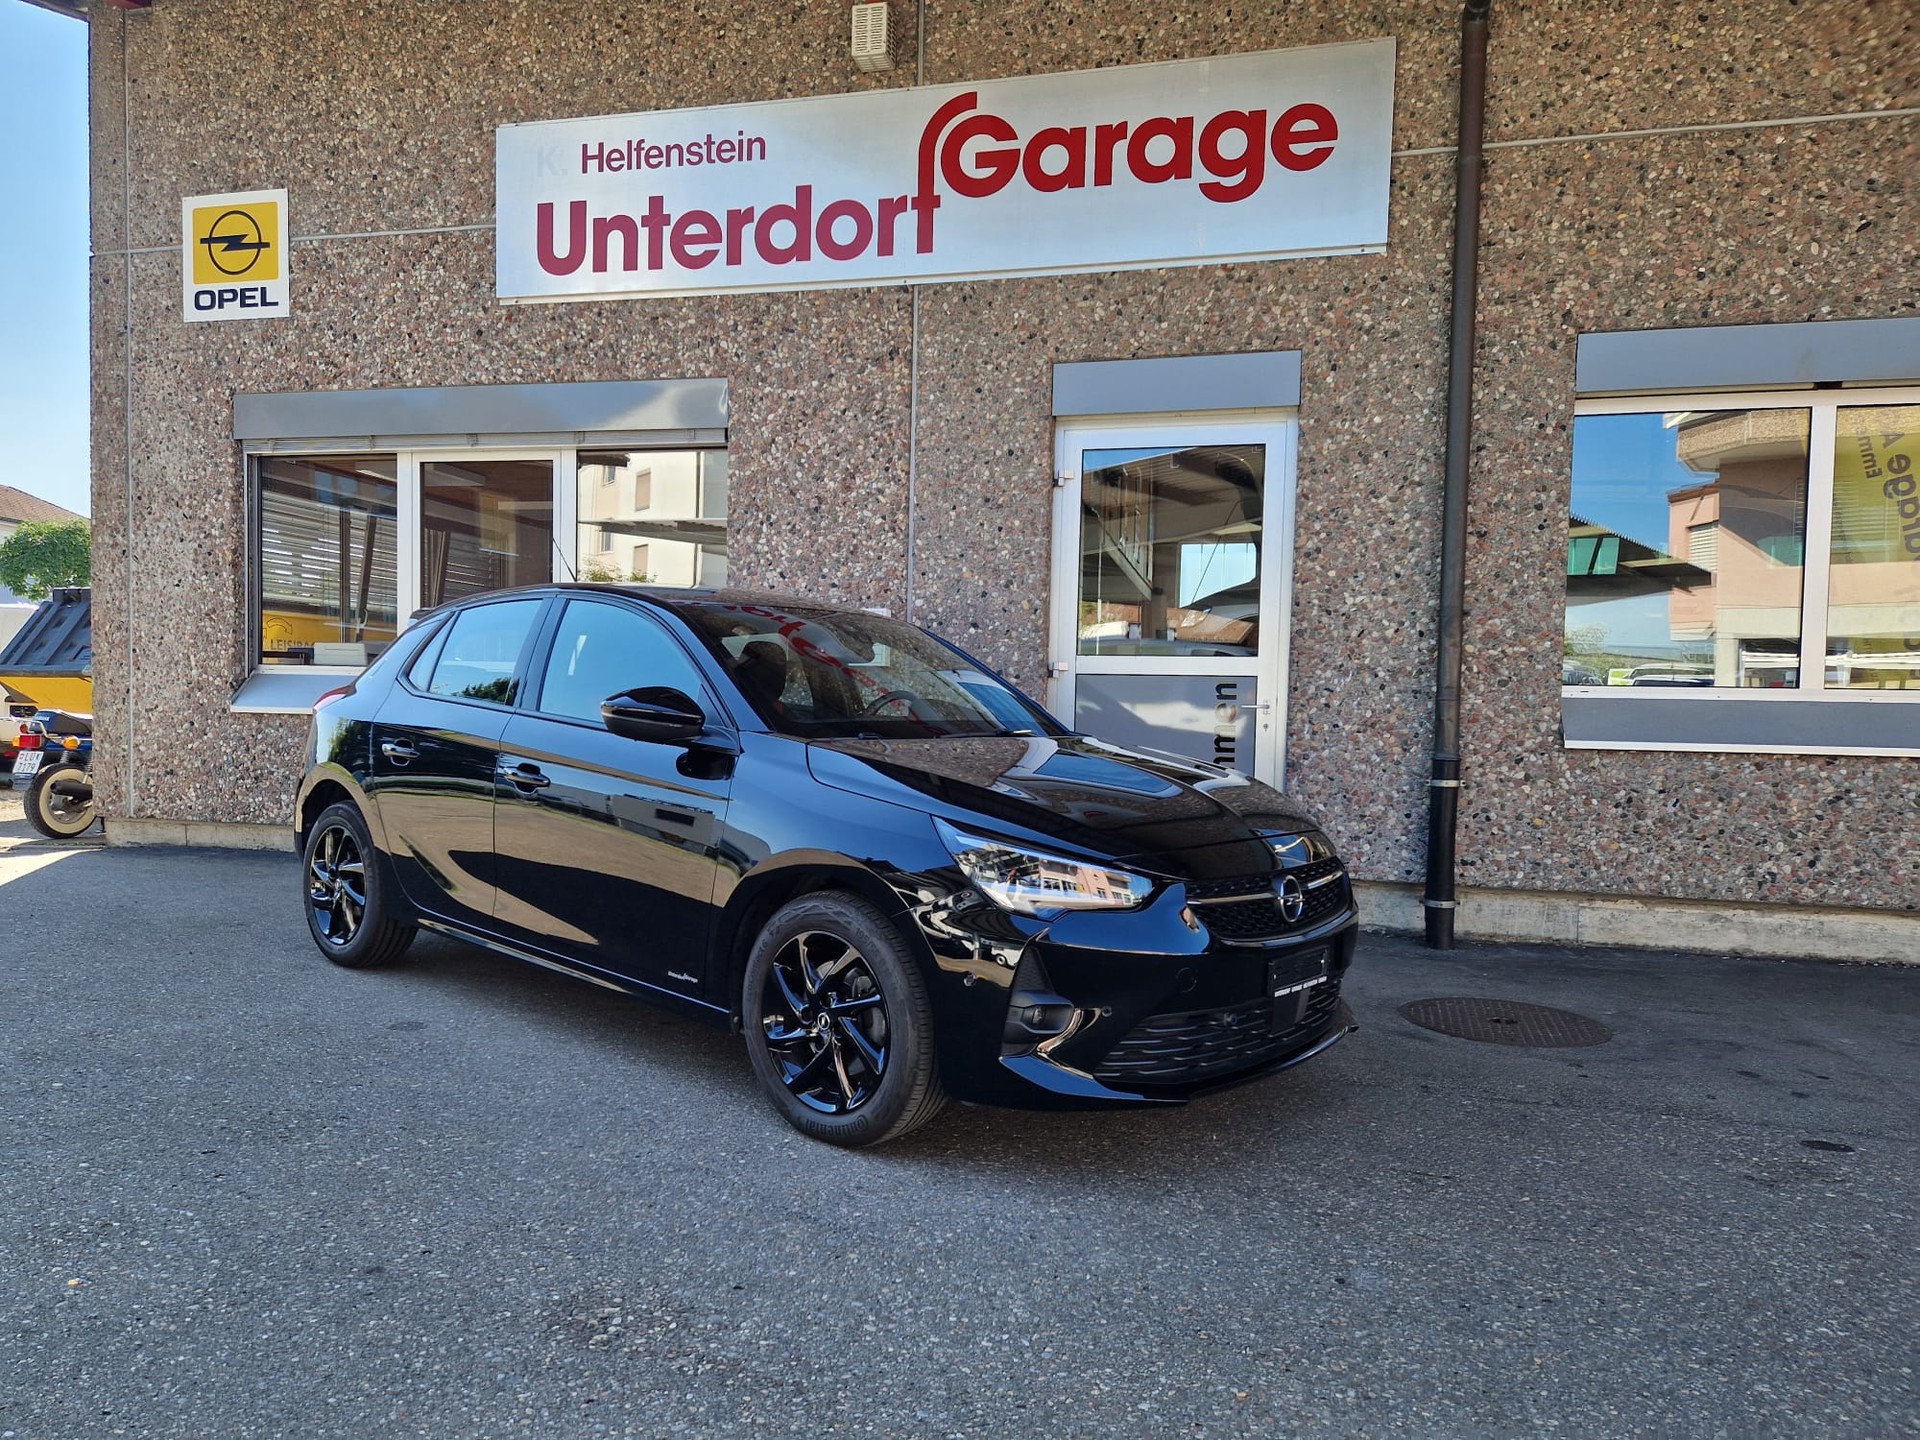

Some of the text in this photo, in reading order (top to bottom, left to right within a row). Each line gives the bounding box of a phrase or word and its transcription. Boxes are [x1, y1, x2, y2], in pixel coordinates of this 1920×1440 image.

[582, 130, 767, 174] Helfenstein
[537, 92, 1339, 277] Unterdorf Garage
[194, 286, 279, 311] OPEL
